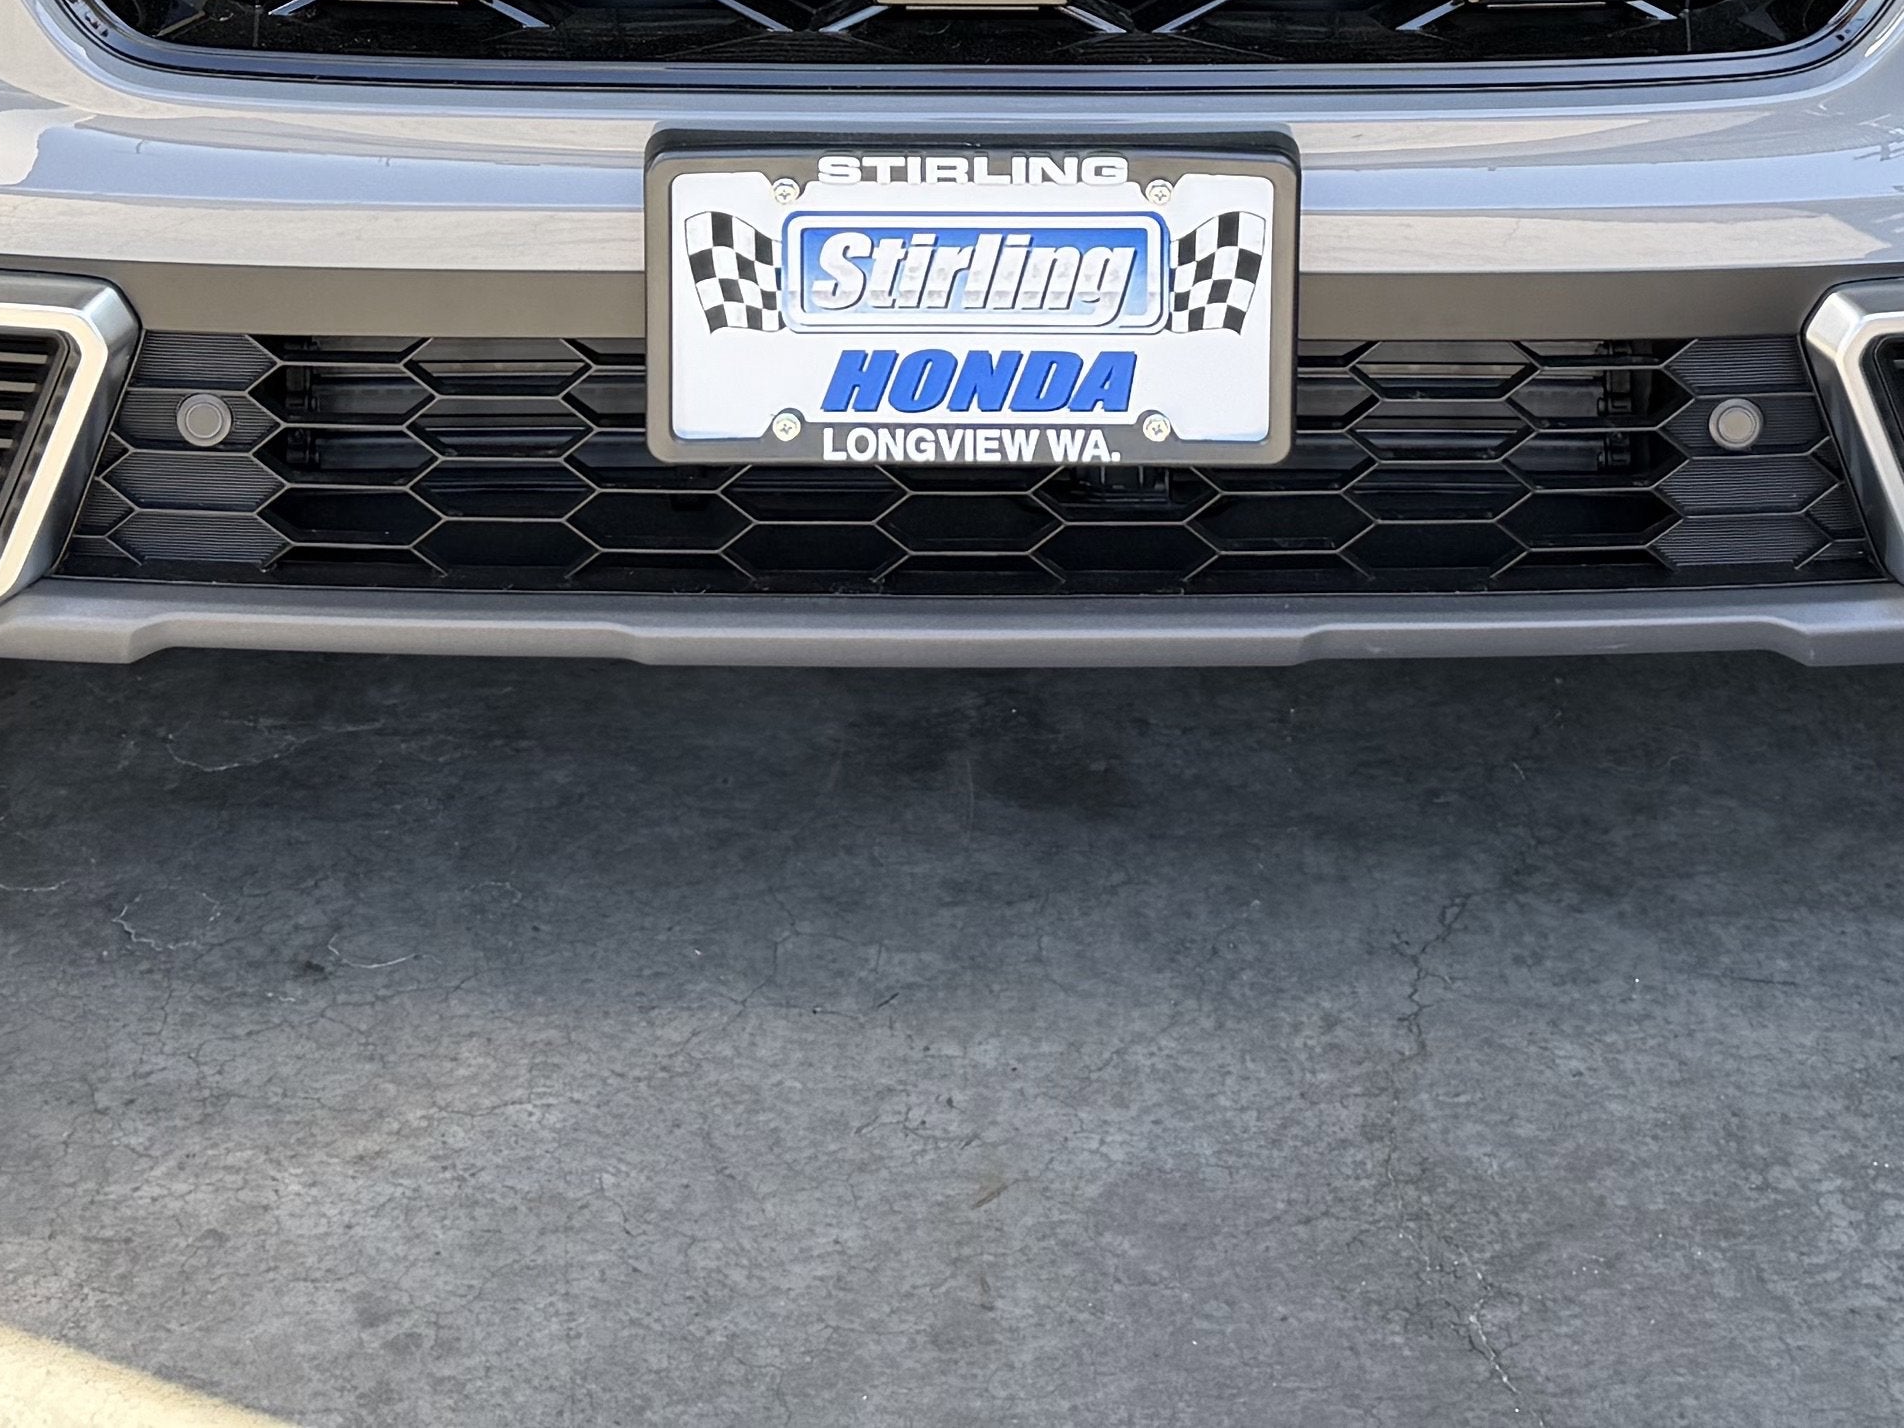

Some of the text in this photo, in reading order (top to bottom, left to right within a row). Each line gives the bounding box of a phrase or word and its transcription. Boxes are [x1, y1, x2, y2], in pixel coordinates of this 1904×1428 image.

[817, 155, 1129, 187] STIRLING
[809, 231, 1136, 328] Stirling
[821, 349, 1136, 413] HONDA
[822, 427, 1121, 462] LONGVIEW WA.
